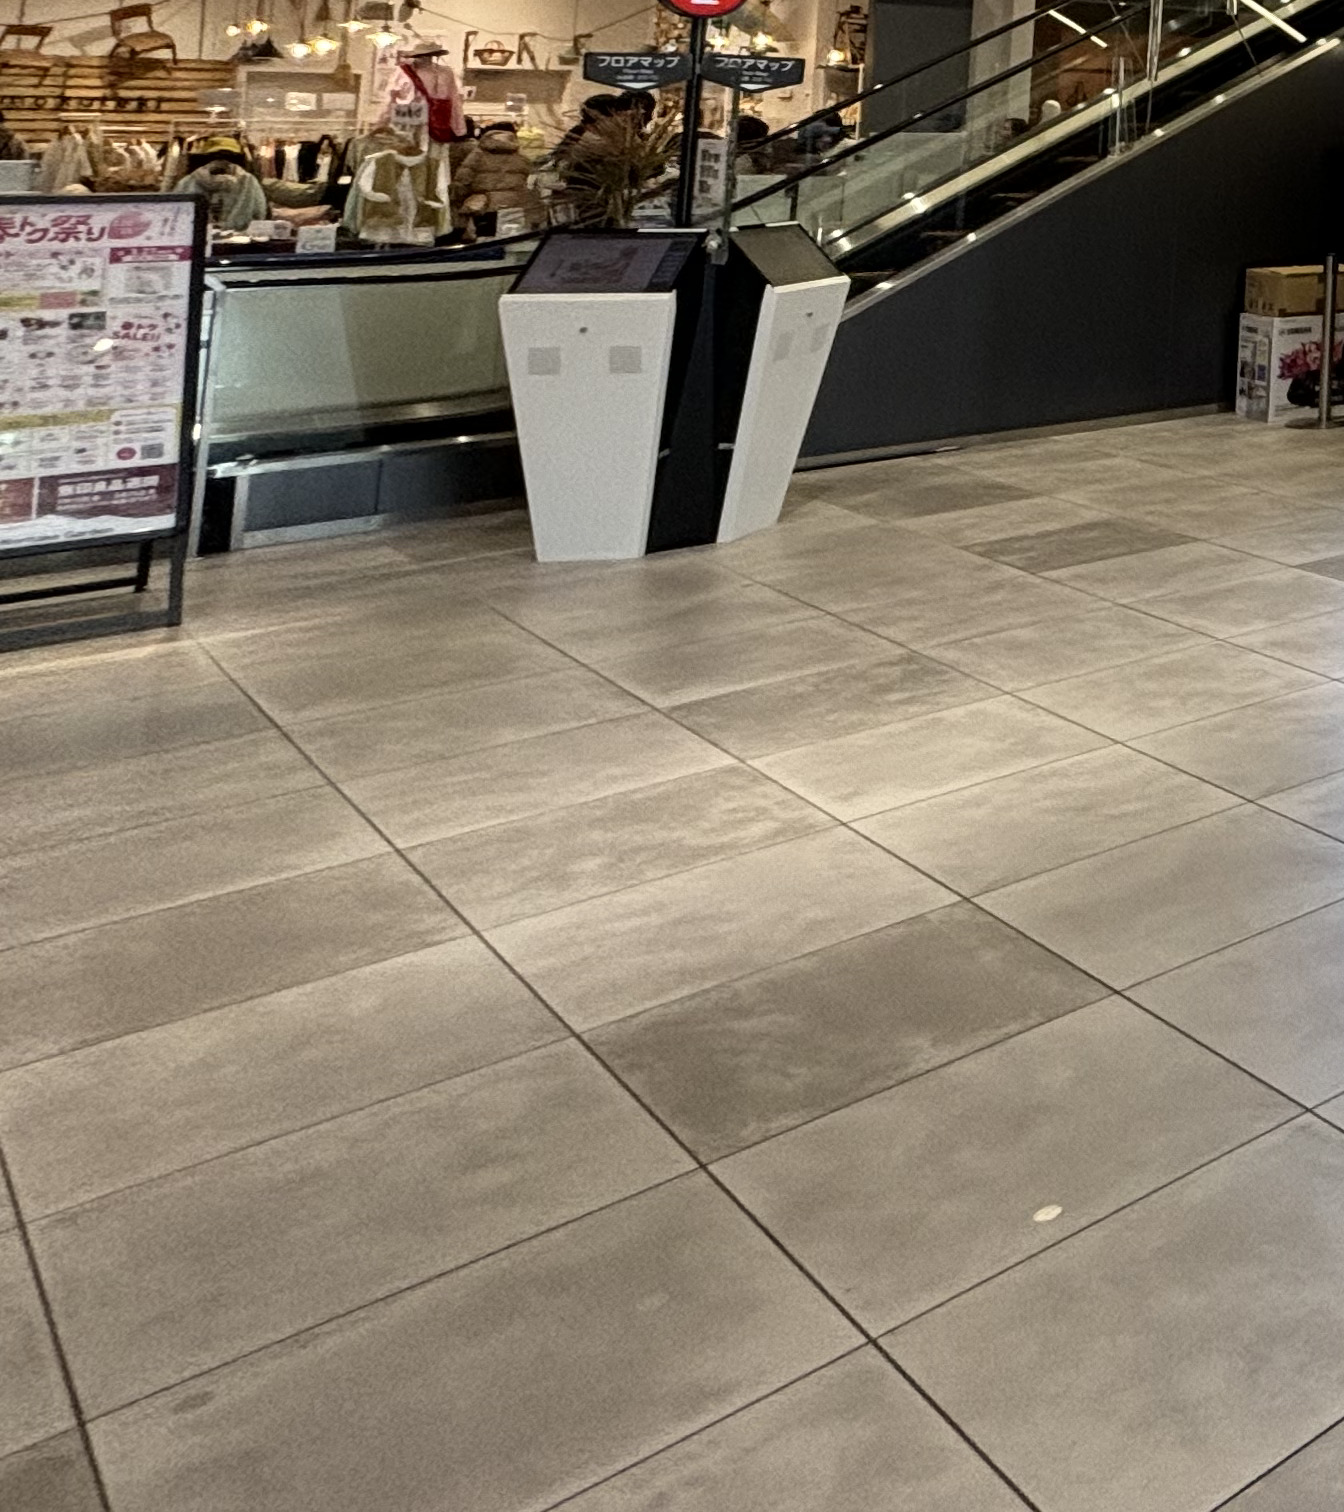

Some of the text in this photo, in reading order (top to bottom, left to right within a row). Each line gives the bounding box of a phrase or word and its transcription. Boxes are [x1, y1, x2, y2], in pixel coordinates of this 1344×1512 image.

[597, 55, 681, 69] フロアマップ
[714, 55, 795, 72] フロアマップ
